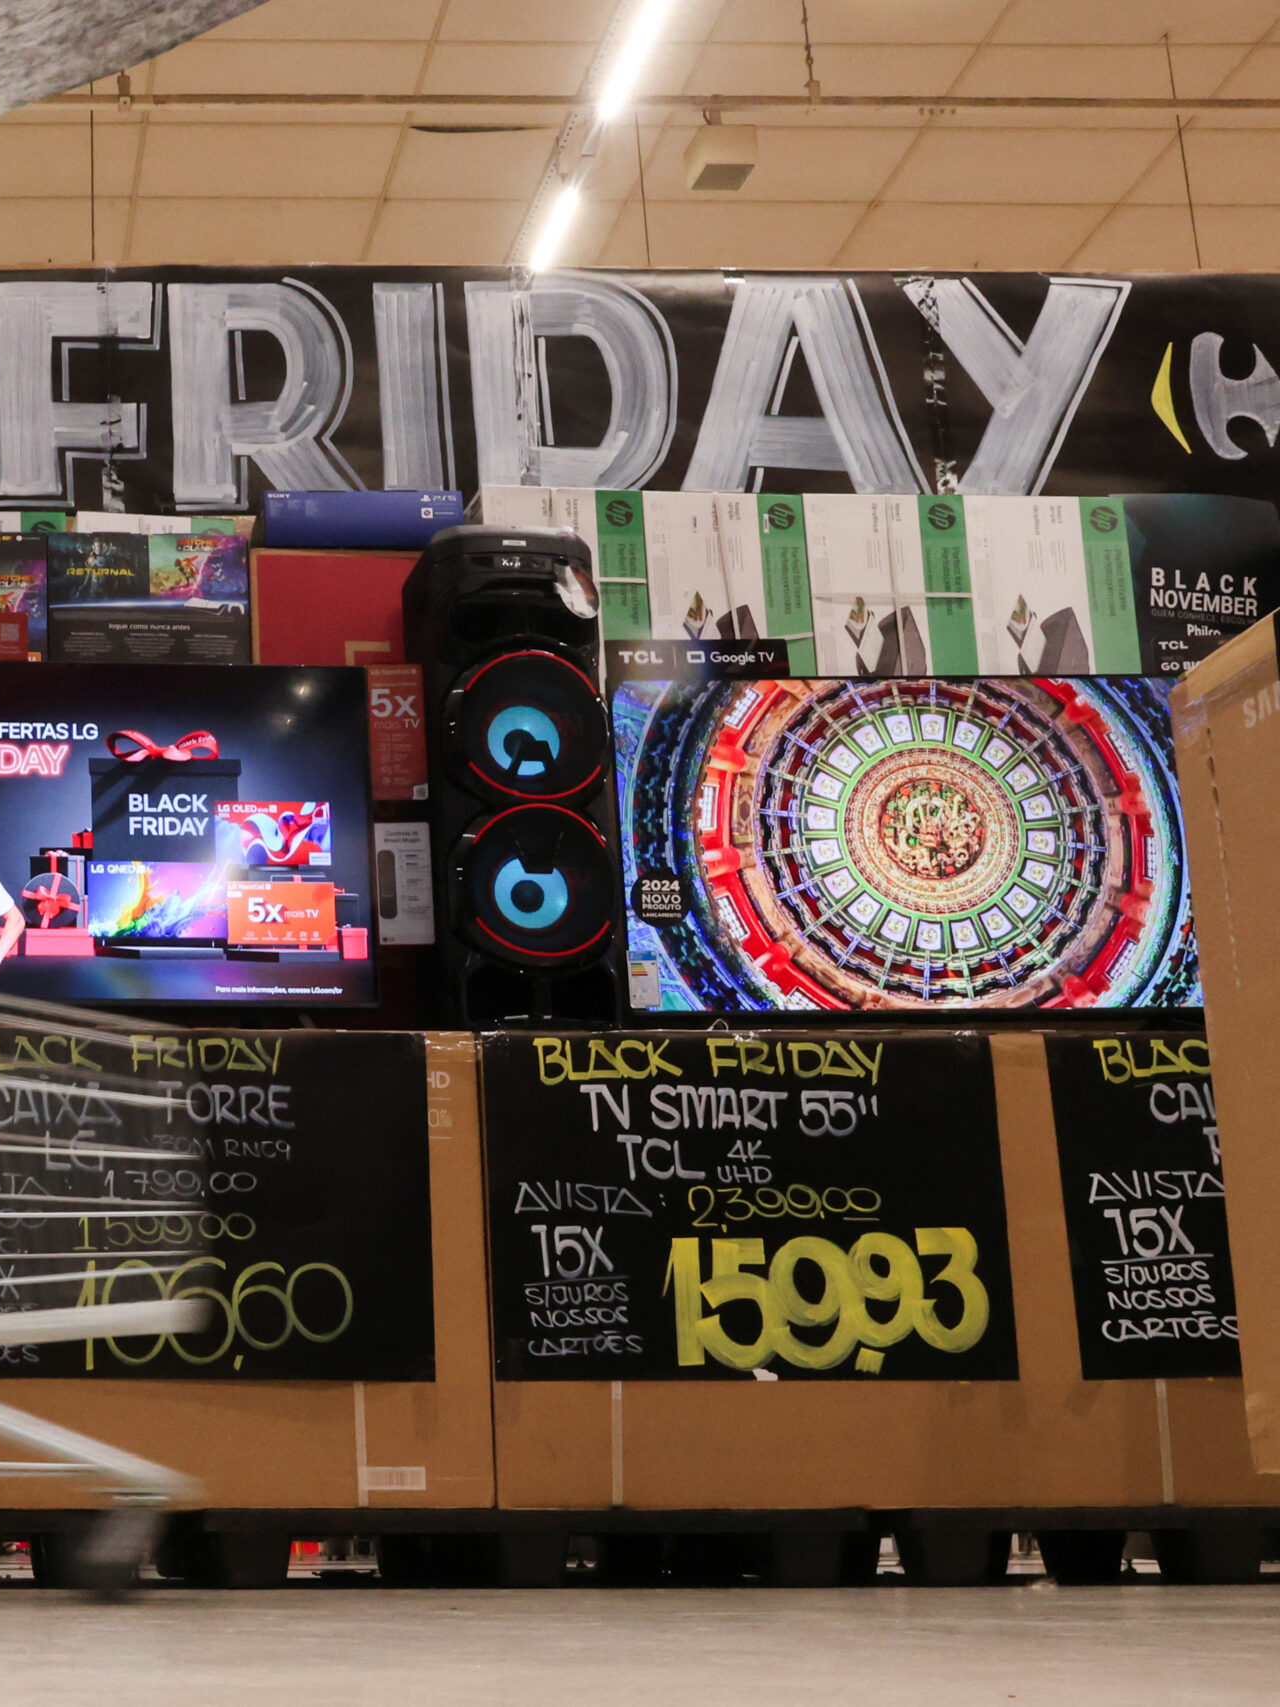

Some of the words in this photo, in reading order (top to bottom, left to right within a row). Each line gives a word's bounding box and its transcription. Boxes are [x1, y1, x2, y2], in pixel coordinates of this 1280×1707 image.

[66, 567, 135, 577] RETURNAL
[1150, 567, 1258, 597] BLACK
[1150, 587, 1258, 617] NOVEMBER
[1151, 608, 1175, 618] QUEM
[1158, 640, 1189, 650] TCL
[619, 651, 663, 664] TCL
[710, 650, 756, 666] Google
[758, 651, 775, 663] TV
[1161, 661, 1179, 671] GO
[371, 688, 418, 718] 5x
[72, 723, 98, 740] LG
[403, 718, 420, 728] TV
[129, 793, 208, 813] BLACK
[217, 804, 230, 813] LG
[232, 804, 258, 813] OLED
[129, 817, 208, 836] FRIDAY
[91, 864, 104, 873] LG
[107, 864, 135, 874] QNED
[641, 879, 680, 892] 2024
[641, 893, 681, 905] NOVO
[641, 903, 681, 911] PRODUTO
[247, 896, 284, 923] 5x
[284, 909, 304, 918] mais
[306, 909, 319, 918] TV
[232, 985, 246, 993] mais
[130, 1034, 282, 1076] FRIDAY
[532, 1038, 684, 1085] BLACK
[706, 1038, 883, 1086] FRIDAY
[1092, 1039, 1212, 1084] BLAC
[156, 1080, 296, 1129] TORRE
[650, 1083, 788, 1131] SMART
[44, 1130, 105, 1172] LG
[617, 1134, 705, 1181] TCL
[727, 1140, 771, 1160] 4K
[717, 1165, 772, 1184] UHD
[1103, 1204, 1195, 1258] 15X
[530, 1223, 615, 1279] 15X
[1107, 1283, 1216, 1311] NOSSOS
[531, 1305, 629, 1327] NOSSOS
